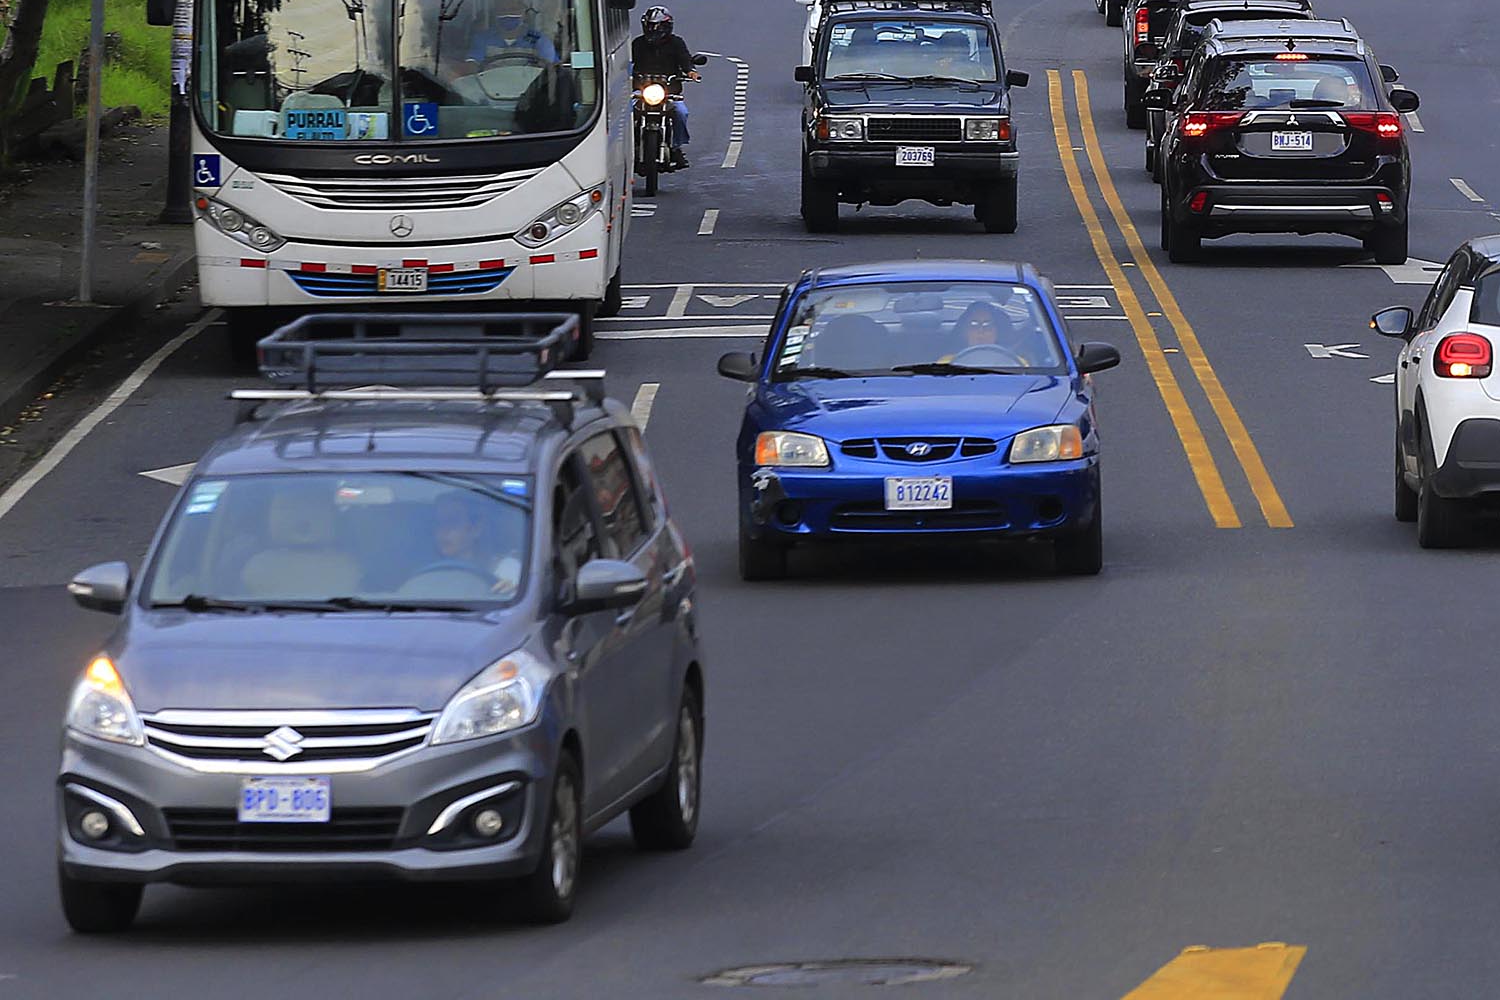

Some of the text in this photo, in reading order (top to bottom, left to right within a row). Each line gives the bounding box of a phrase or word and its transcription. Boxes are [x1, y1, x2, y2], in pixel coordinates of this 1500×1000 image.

[287, 113, 343, 128] PURRAL
[354, 154, 440, 165] COMIL
[902, 152, 932, 161] 203769
[896, 485, 948, 501] 812242
